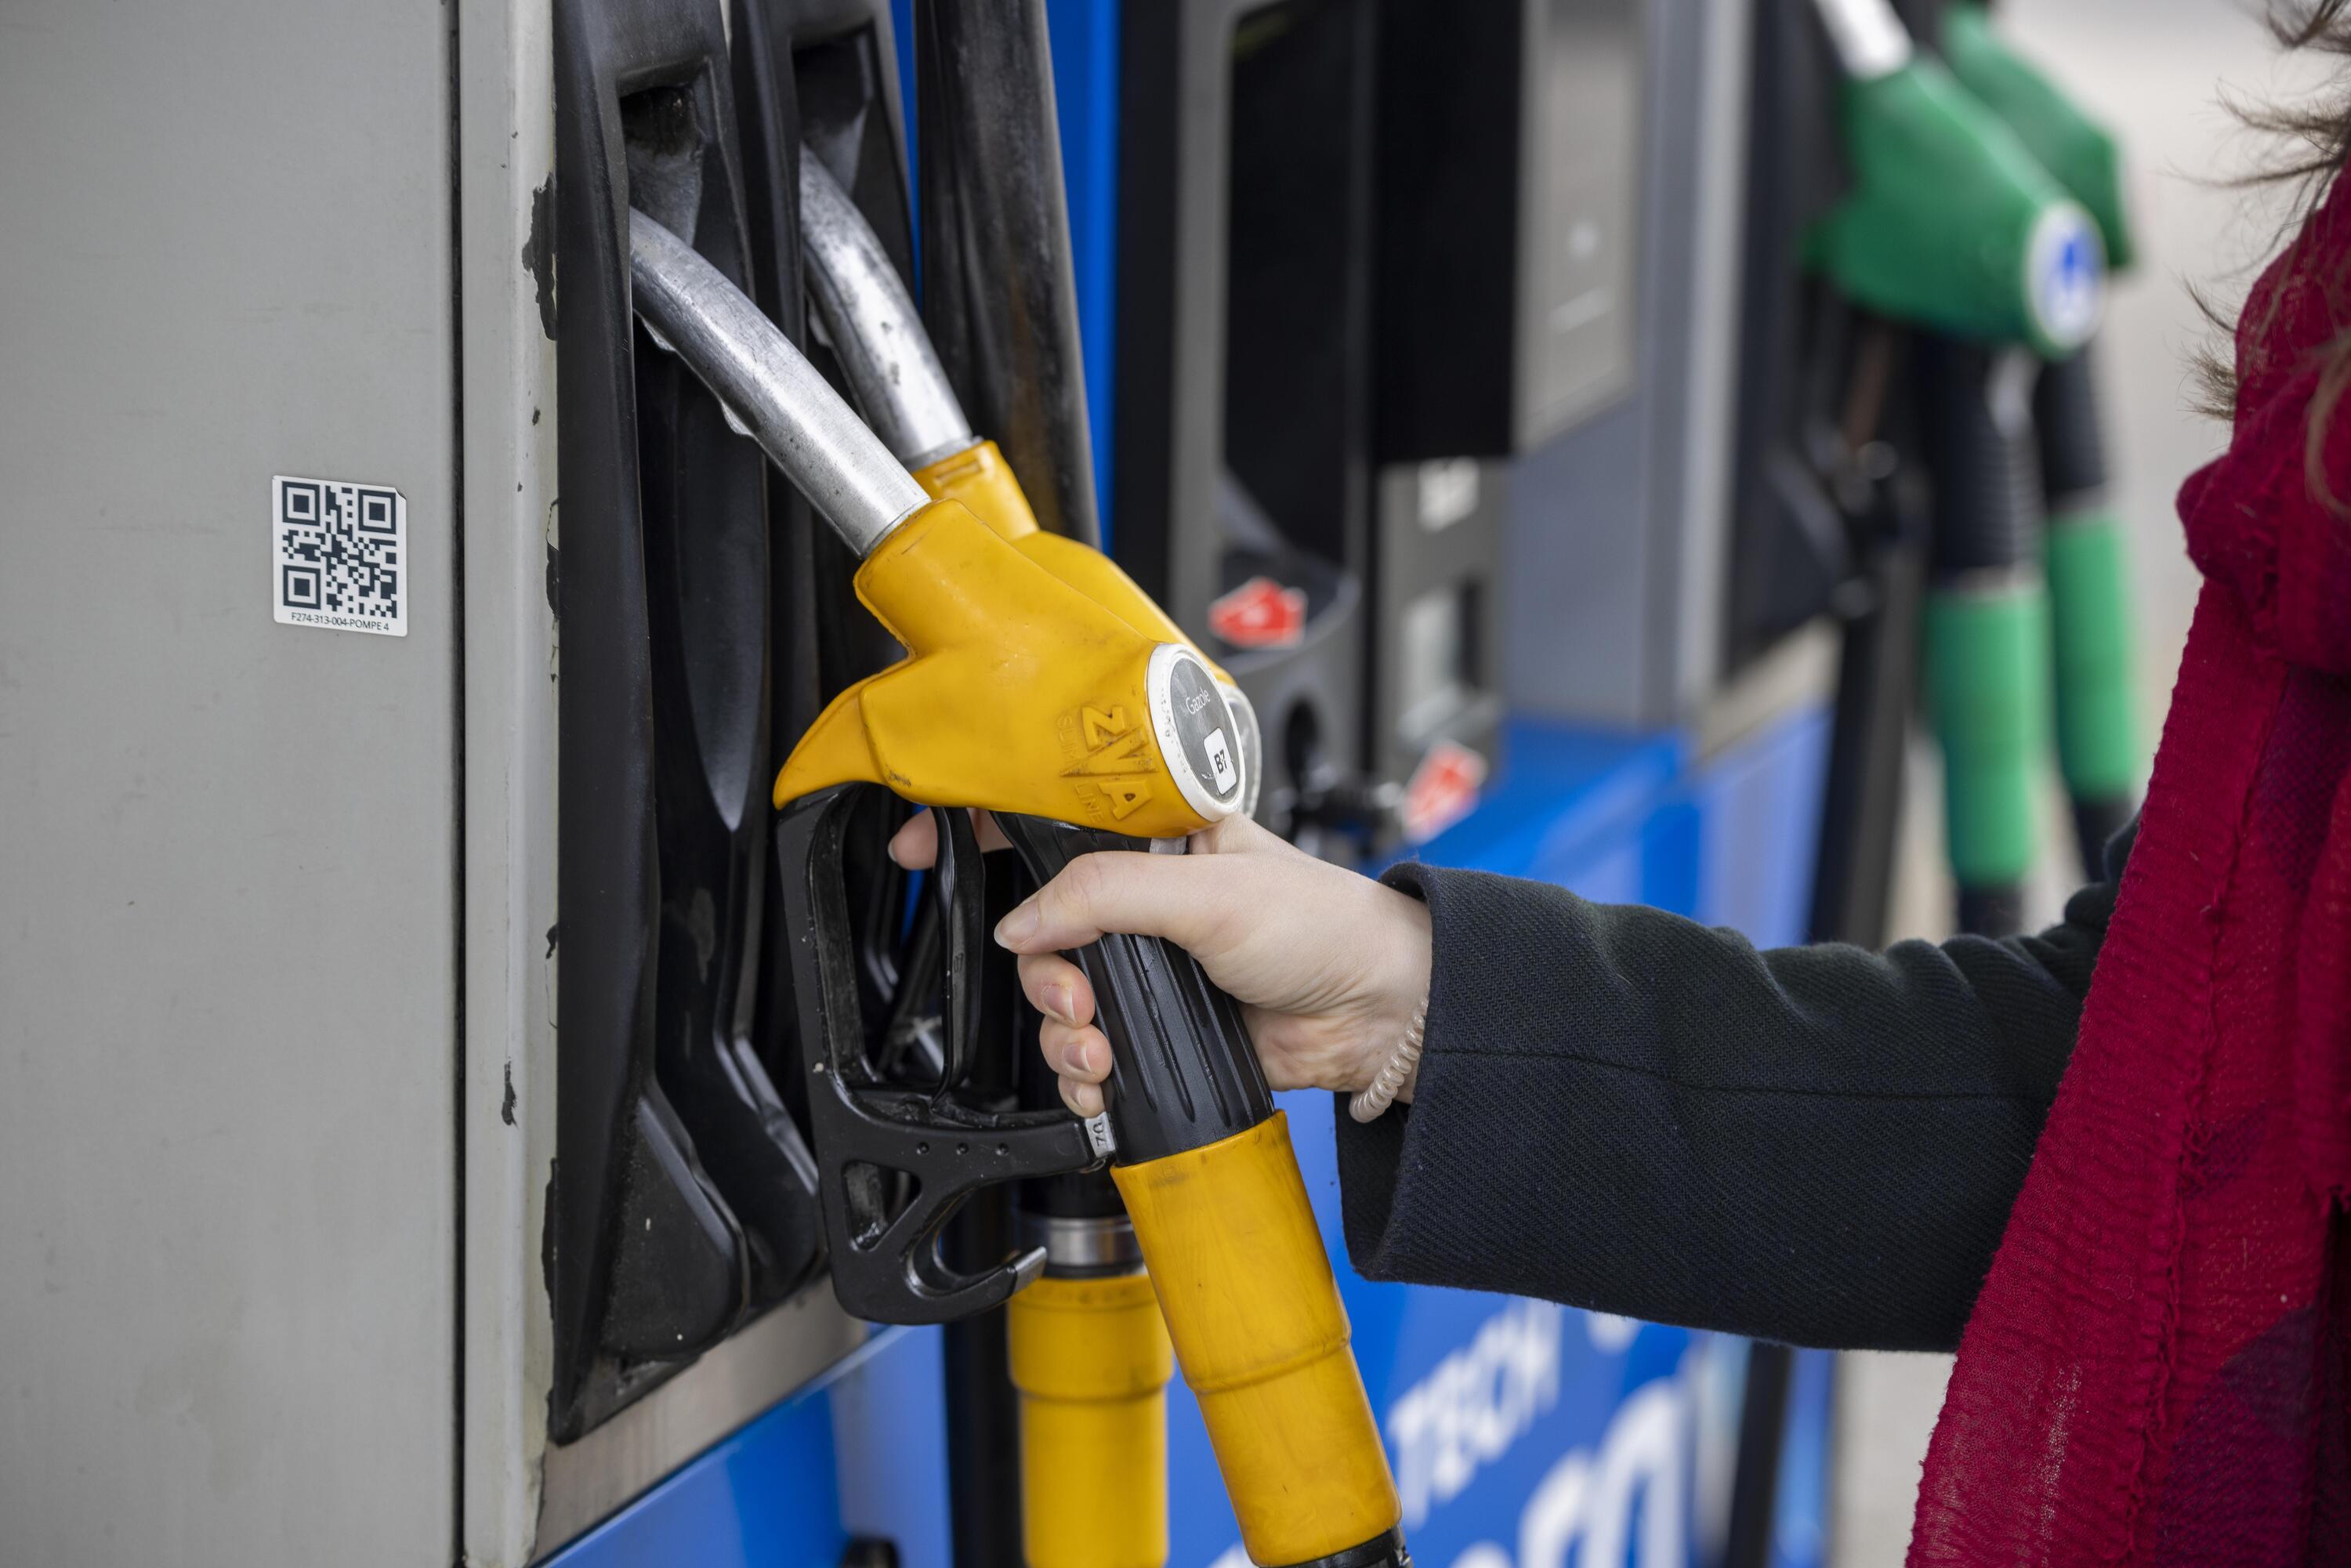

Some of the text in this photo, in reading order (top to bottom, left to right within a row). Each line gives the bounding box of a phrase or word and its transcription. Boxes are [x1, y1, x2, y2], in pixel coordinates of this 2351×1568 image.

[291, 612, 389, 631] F274-313-004-POMPE 4
[1186, 686, 1211, 715] Gazole
[1214, 749, 1227, 774] B7
[1074, 784, 1105, 823] LINE
